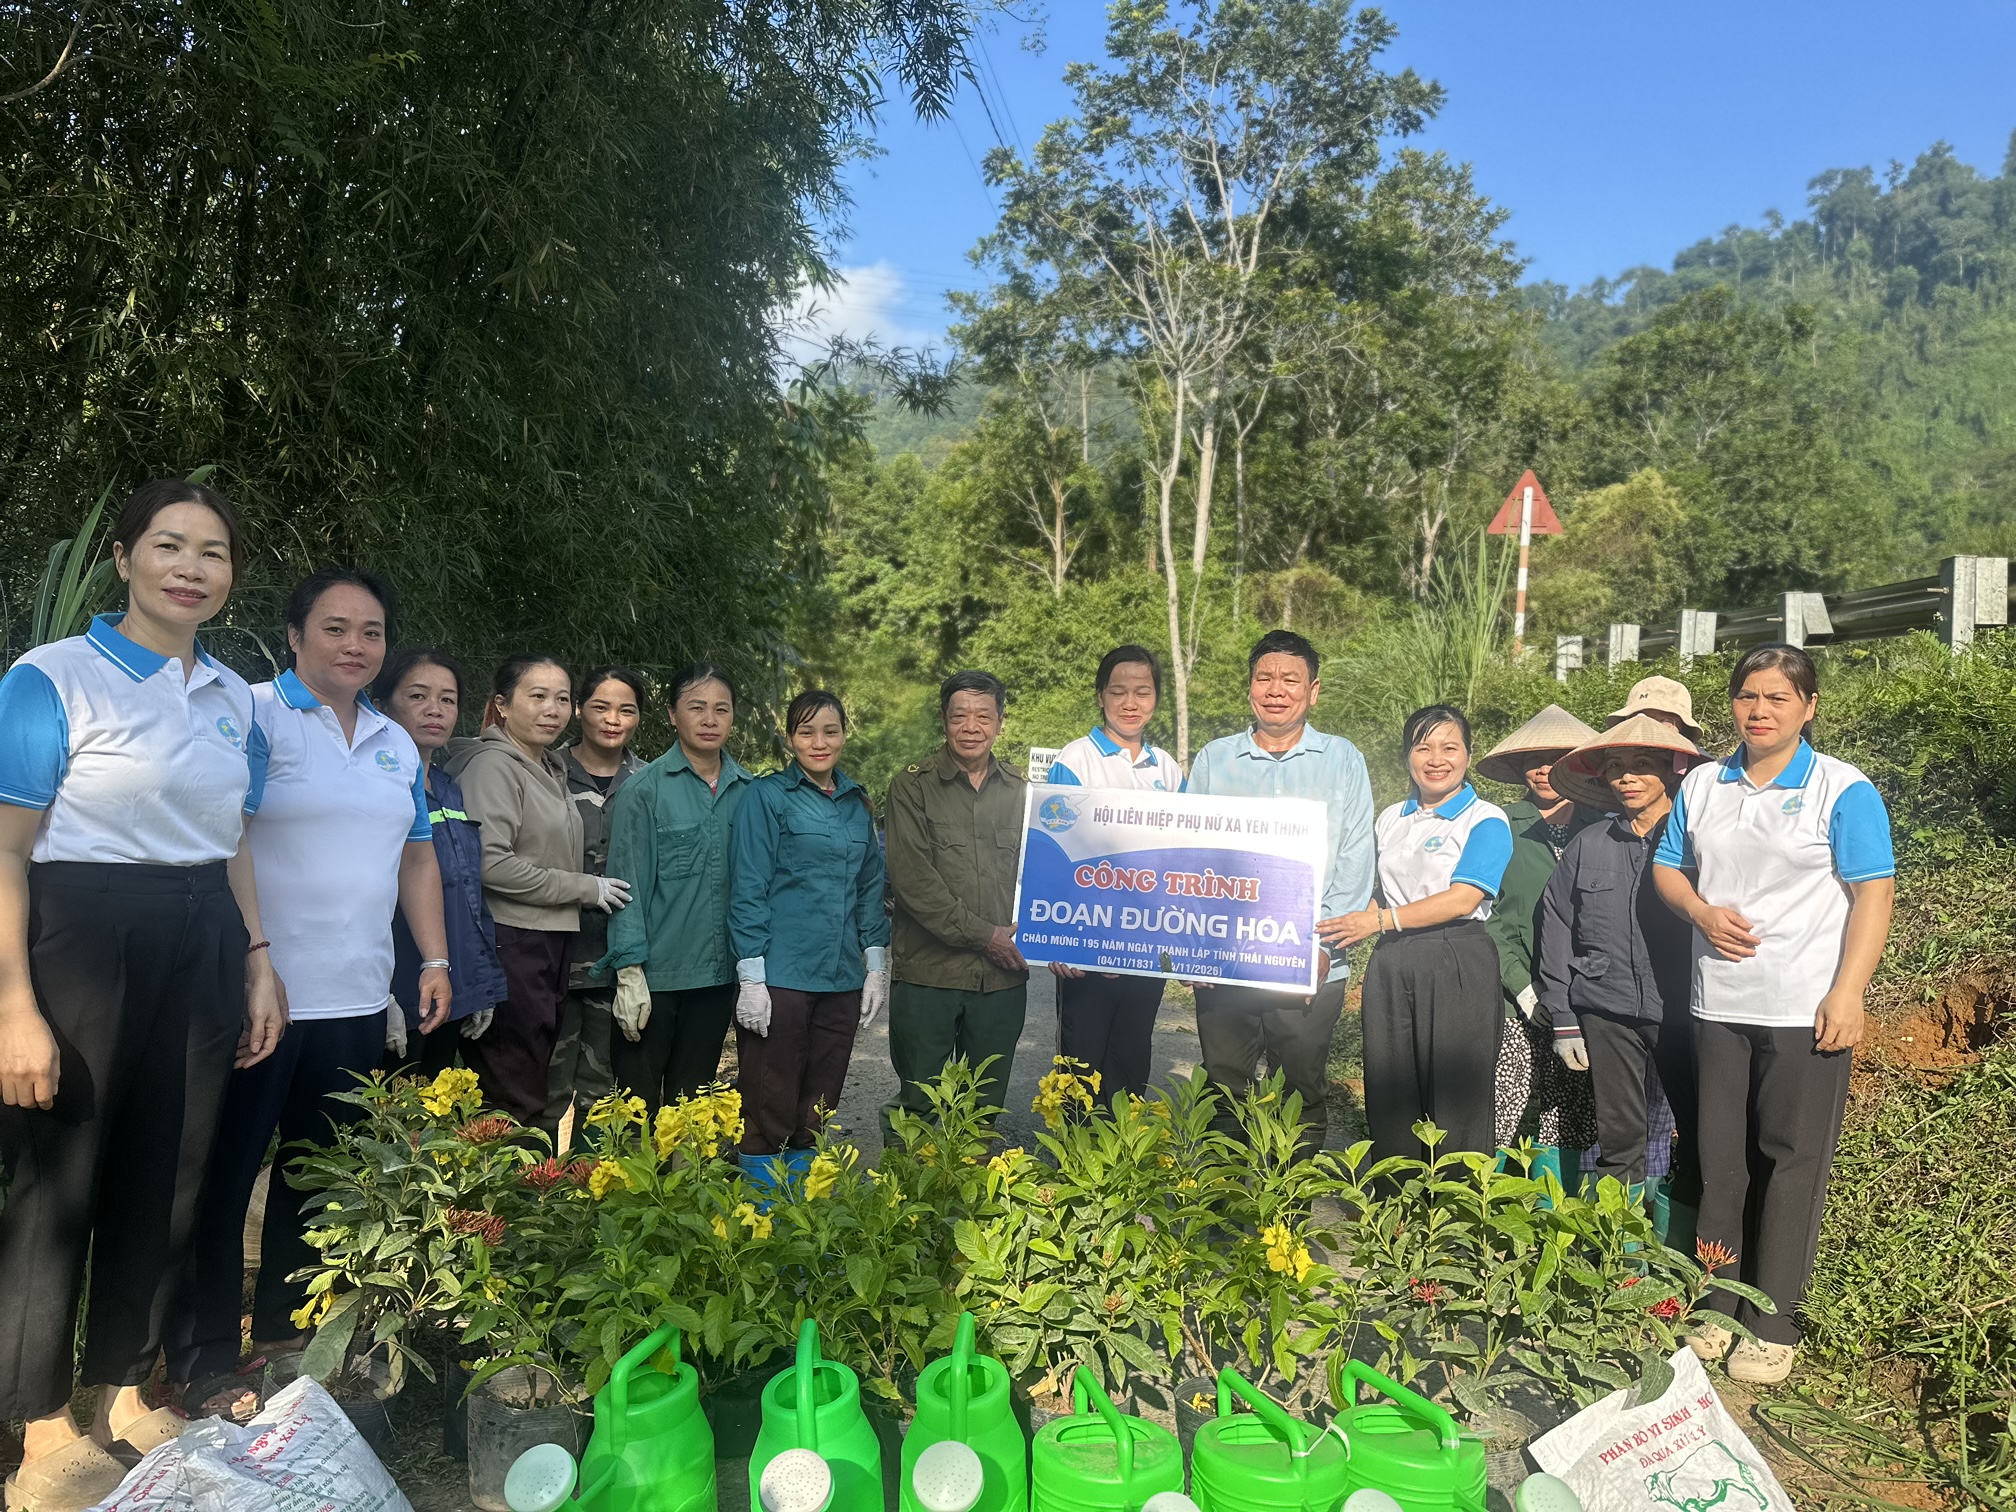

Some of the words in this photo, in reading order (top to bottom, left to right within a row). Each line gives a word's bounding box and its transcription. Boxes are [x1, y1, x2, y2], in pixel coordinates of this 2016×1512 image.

[1031, 752, 1044, 763] KHU
[1093, 805, 1113, 826] HỘI
[1117, 807, 1143, 826] LIÊN
[1146, 809, 1174, 830] HIỆP
[1177, 812, 1202, 833] PHỤ
[1075, 860, 1157, 893] CÔNG
[1164, 868, 1261, 902] TRÌNH
[1030, 899, 1113, 932] ĐOẠN
[1120, 905, 1229, 938] ĐƯỜNG
[1022, 932, 1048, 944] CHÀO
[1050, 935, 1079, 947] MỪNG
[1082, 938, 1099, 949] 195
[1102, 939, 1125, 951] NĂM
[1127, 941, 1154, 954] NGÀY
[1191, 947, 1211, 961] LẬP
[1239, 951, 1262, 964] THÁI
[1264, 954, 1306, 969] NGUYÊN
[1097, 955, 1154, 970] (04/11/1831
[1661, 1406, 1693, 1431] SINH
[1651, 1445, 1675, 1463] QUA
